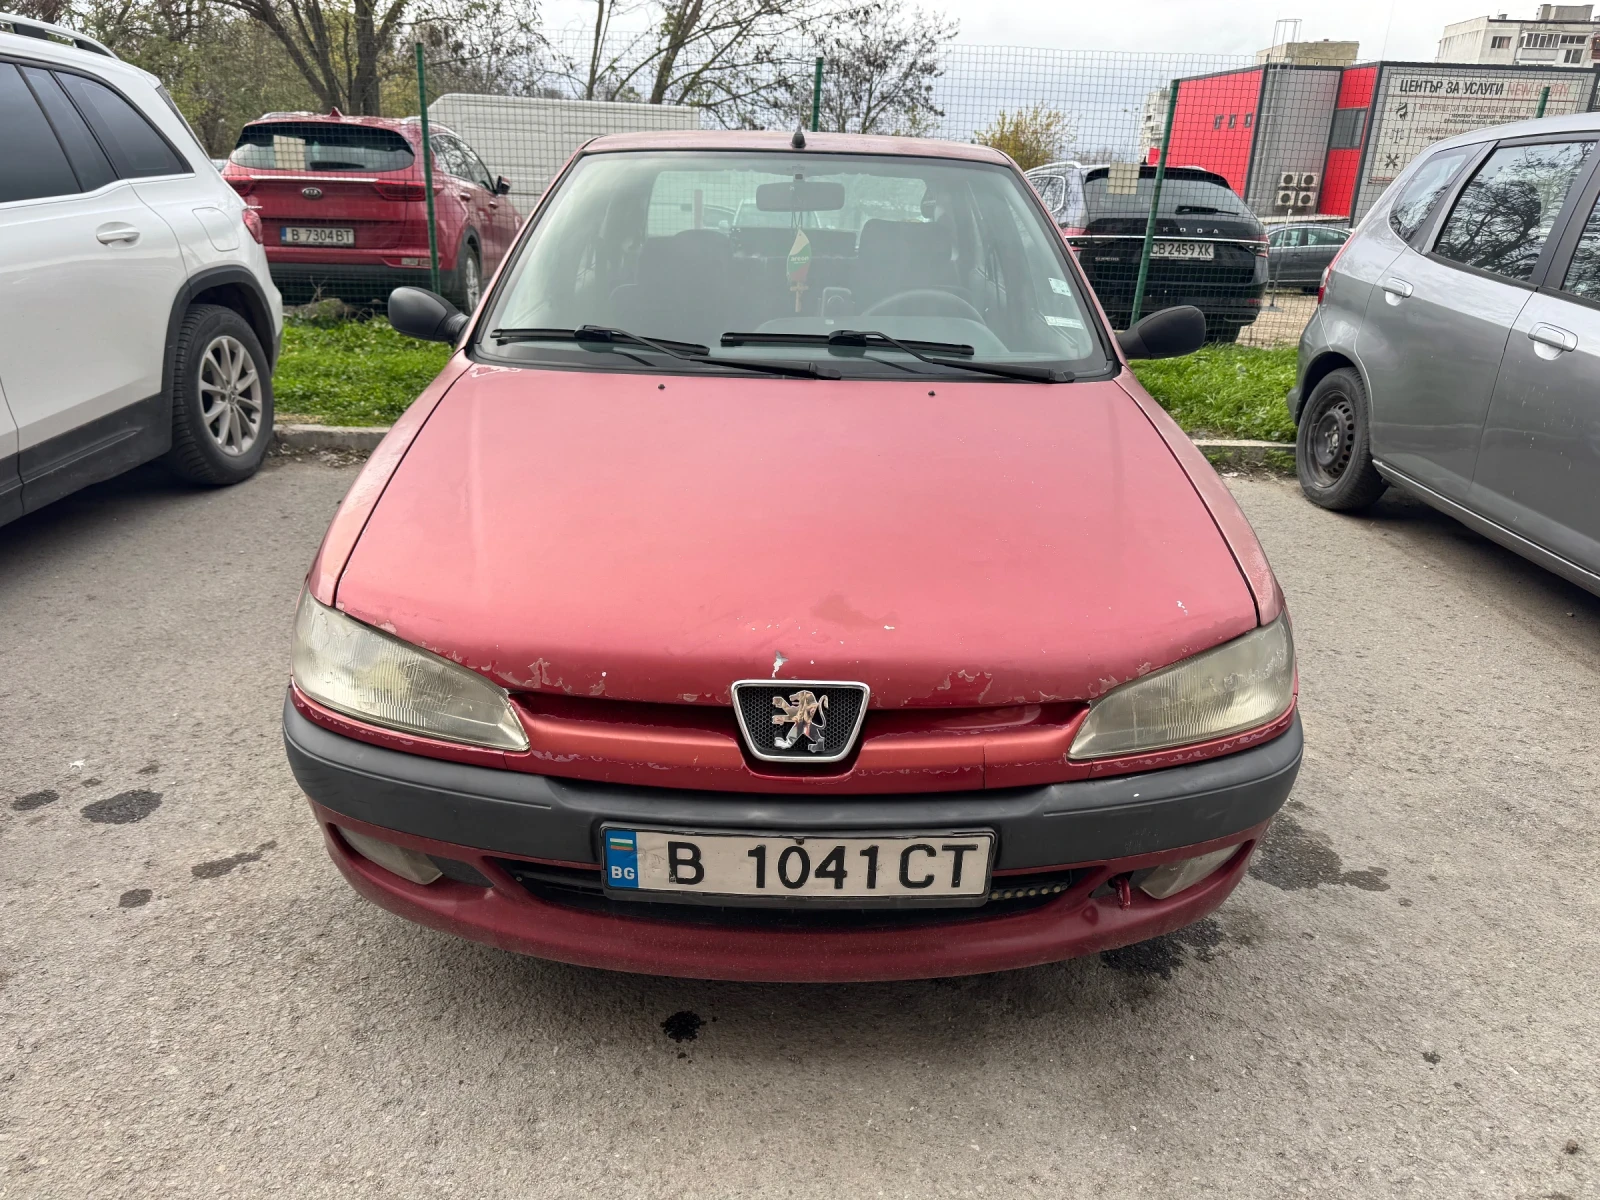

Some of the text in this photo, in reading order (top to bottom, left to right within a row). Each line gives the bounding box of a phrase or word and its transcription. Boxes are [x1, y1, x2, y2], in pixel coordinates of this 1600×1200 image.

[1400, 80, 1504, 96] ЦЕНТЪР ЗА УСЛУГИ
[291, 229, 351, 242] B 7304 BT
[1146, 225, 1219, 234] KODA
[1151, 243, 1212, 257] CB 2459 XK
[611, 865, 635, 880] BG
[667, 841, 979, 890] B 1041 CT
